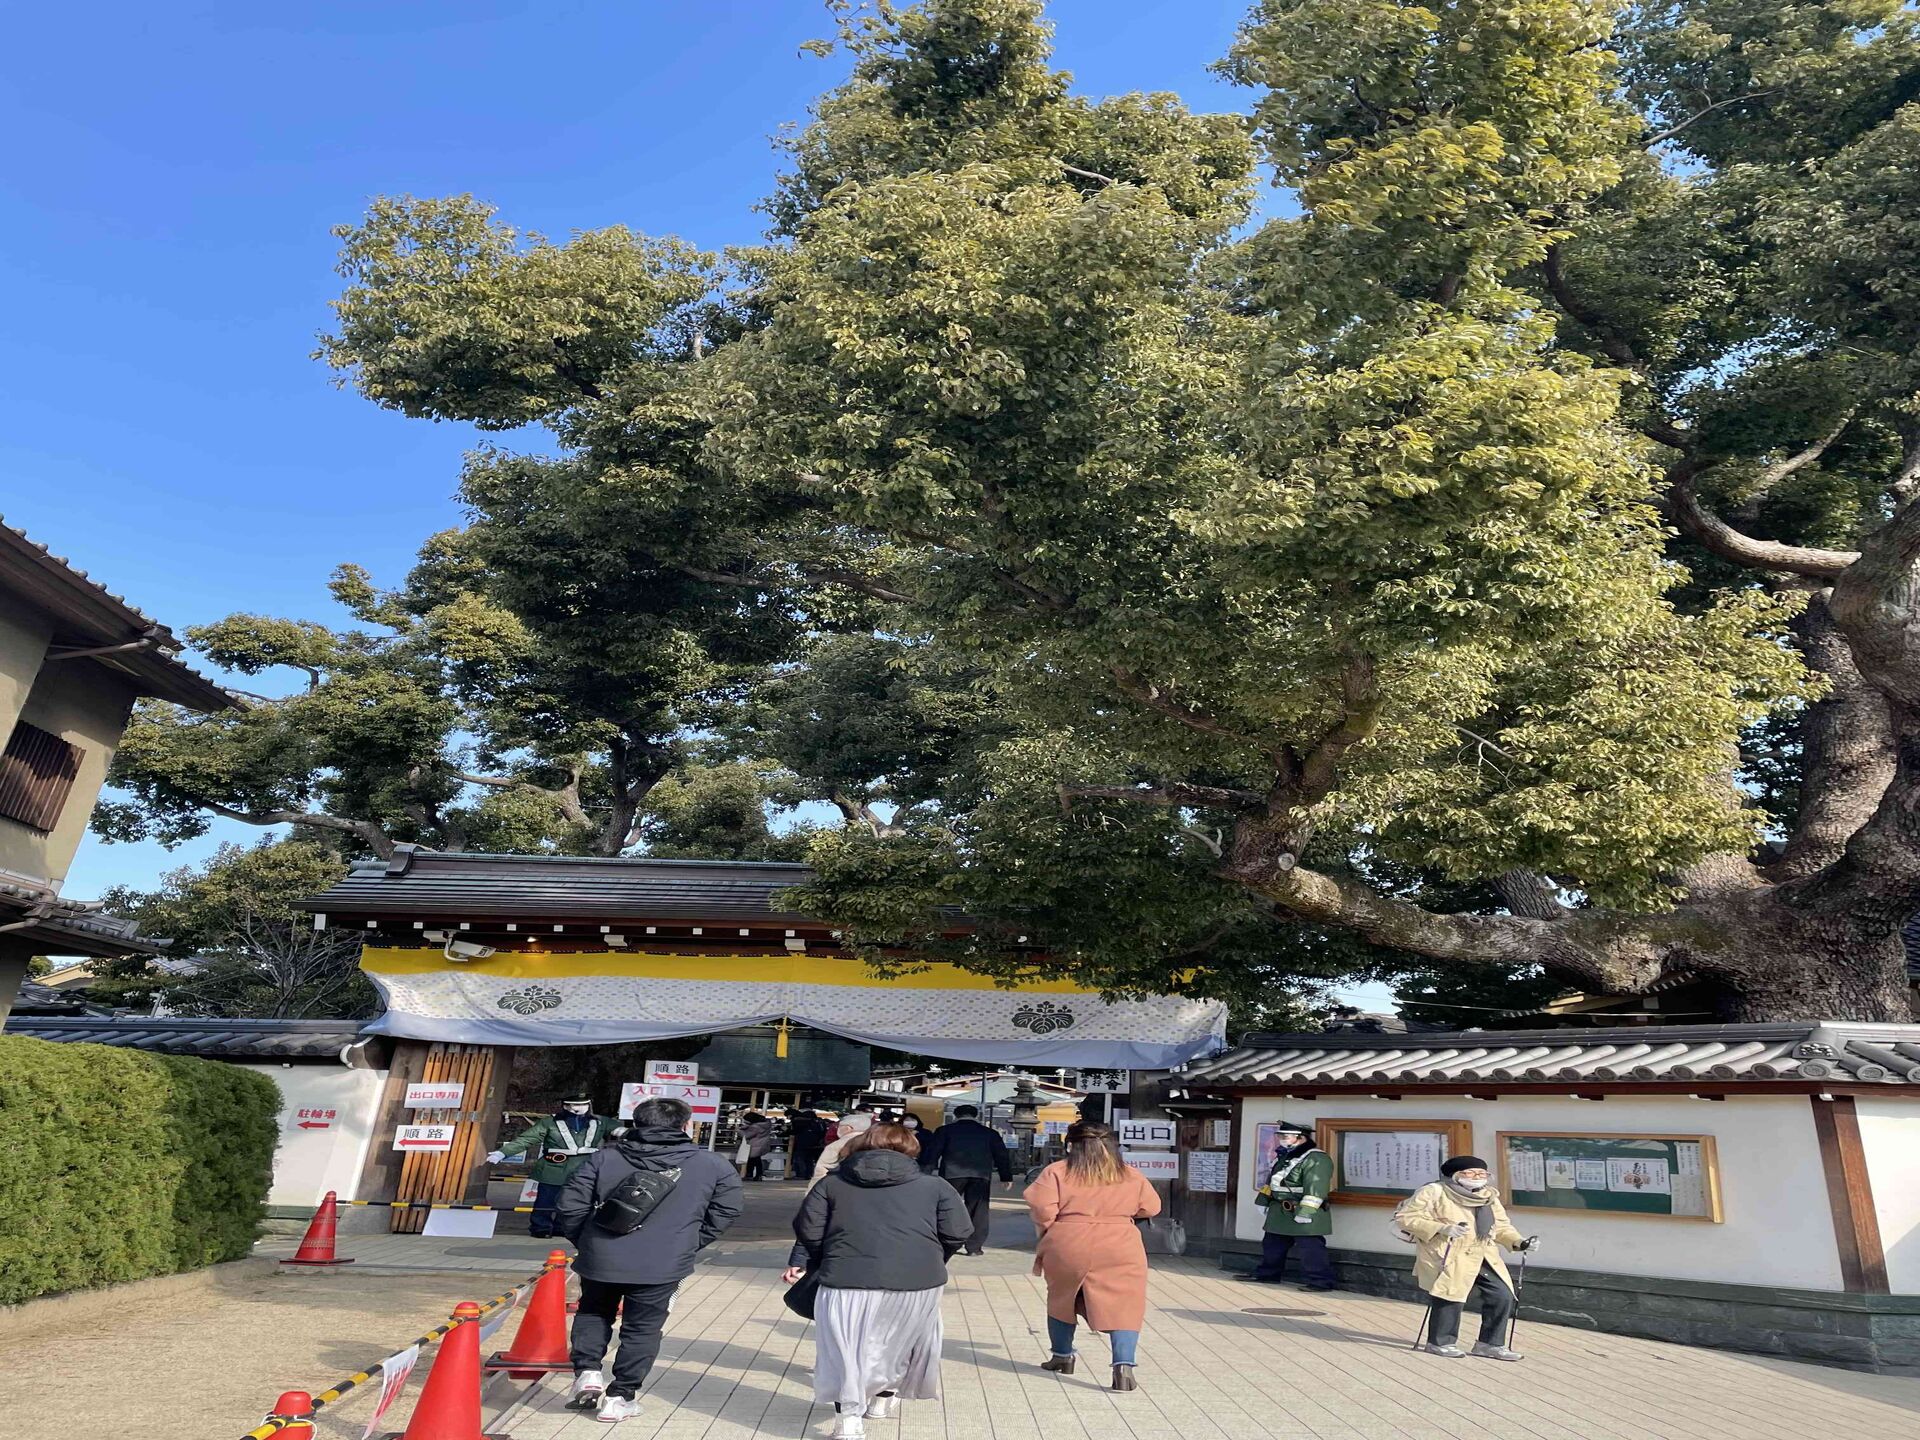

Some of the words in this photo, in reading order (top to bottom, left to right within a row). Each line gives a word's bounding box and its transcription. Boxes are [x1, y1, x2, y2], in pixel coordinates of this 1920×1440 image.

[655, 1063, 690, 1074] 順路
[410, 1091, 459, 1099] 出口専用
[633, 1085, 662, 1095] 入口
[682, 1087, 710, 1098] 入口
[297, 1109, 337, 1120] 駐輪場
[403, 1128, 443, 1139] 順路
[1123, 1125, 1171, 1141] 出口
